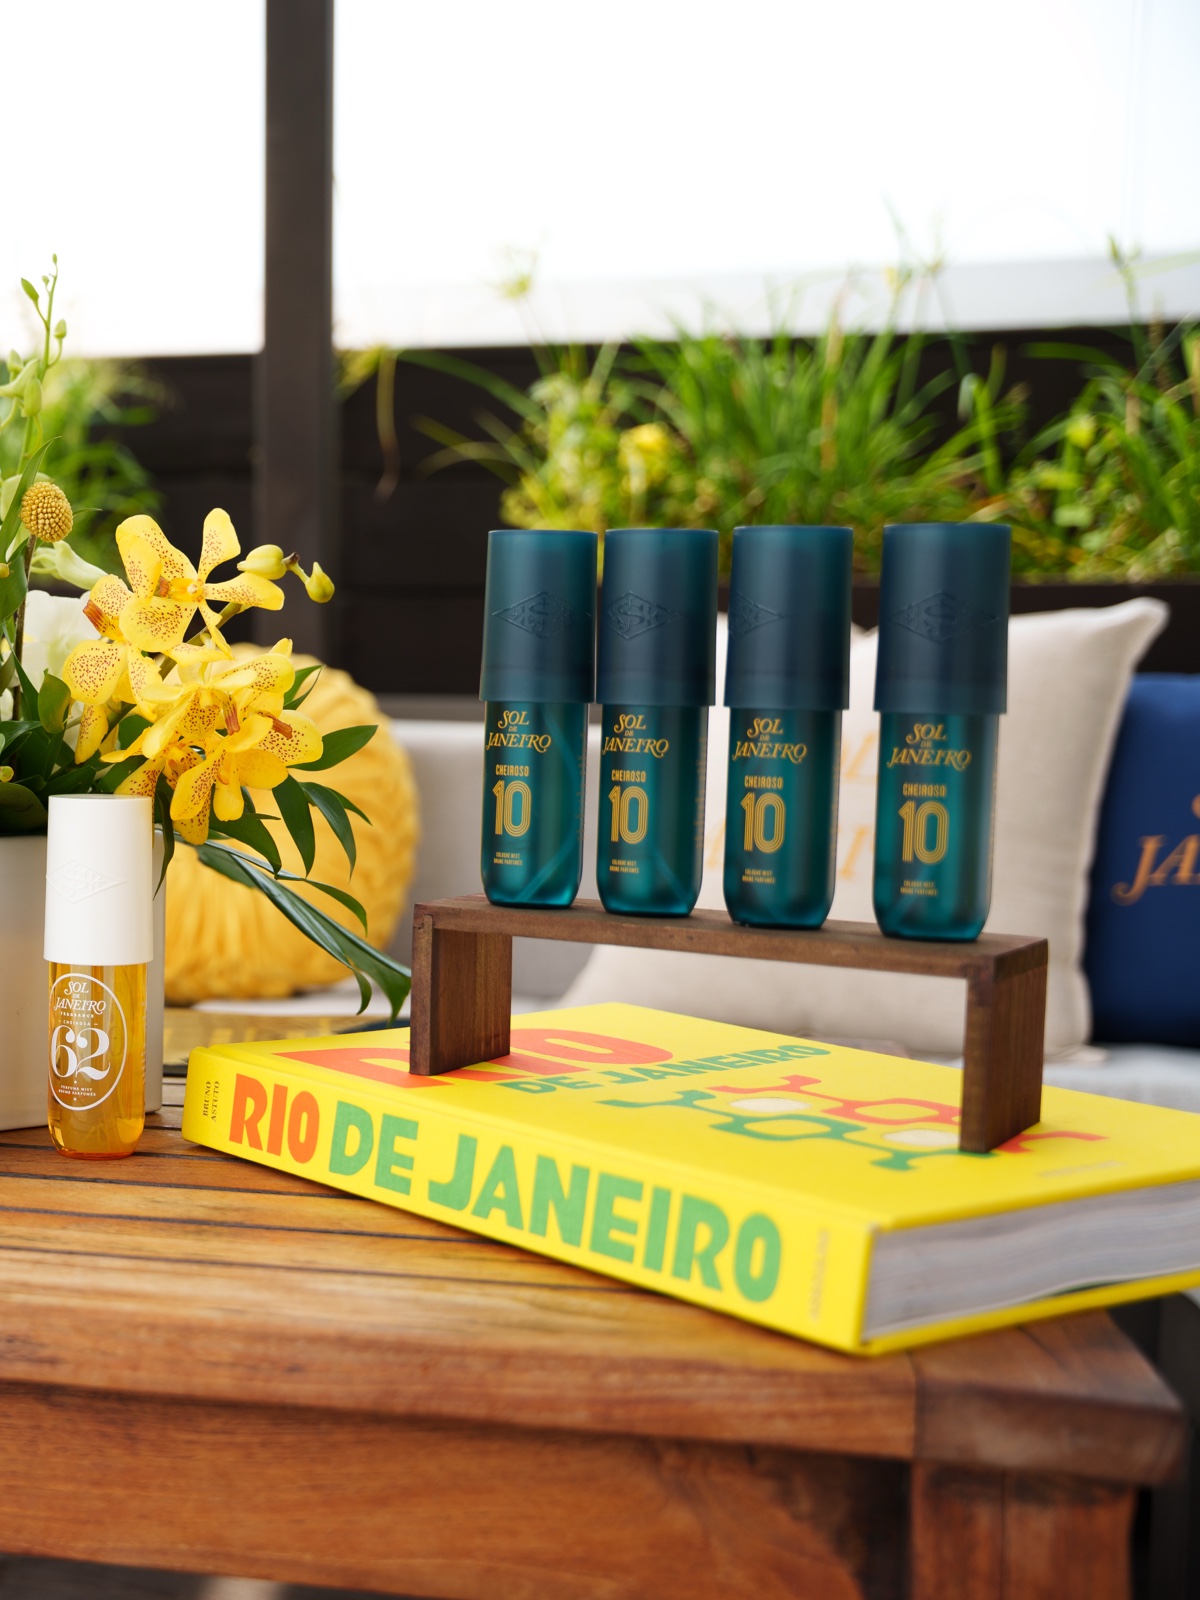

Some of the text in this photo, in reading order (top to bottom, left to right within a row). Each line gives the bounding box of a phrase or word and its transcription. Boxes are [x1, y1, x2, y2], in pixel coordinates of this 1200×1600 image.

[498, 711, 530, 729] SOL
[613, 714, 646, 733] SOL
[747, 717, 783, 738] SOL
[486, 732, 552, 753] JANEIRO
[906, 723, 946, 744] SOL
[602, 736, 669, 758] JANEIRO
[732, 741, 807, 764] JANEIRO
[495, 764, 530, 777] CHEIROSO
[886, 747, 972, 772] JANEIRO
[611, 769, 646, 783] CHEIROSO
[744, 775, 783, 789] CHEIROSO
[902, 783, 947, 797] CHEIROSO
[492, 780, 532, 837] 10
[608, 785, 648, 844] 10
[740, 792, 786, 853] 10
[898, 800, 949, 864] 10
[64, 981, 89, 995] SOL
[54, 997, 107, 1015] JANEIRO
[52, 1025, 111, 1080] 62
[494, 1045, 831, 1094] DE JANEIRO
[203, 1081, 211, 1117] BRUNO
[211, 1081, 220, 1122] ASTUTO
[228, 1073, 320, 1164] RIO
[329, 1101, 419, 1197] DE
[428, 1133, 782, 1304] JANEIRO
